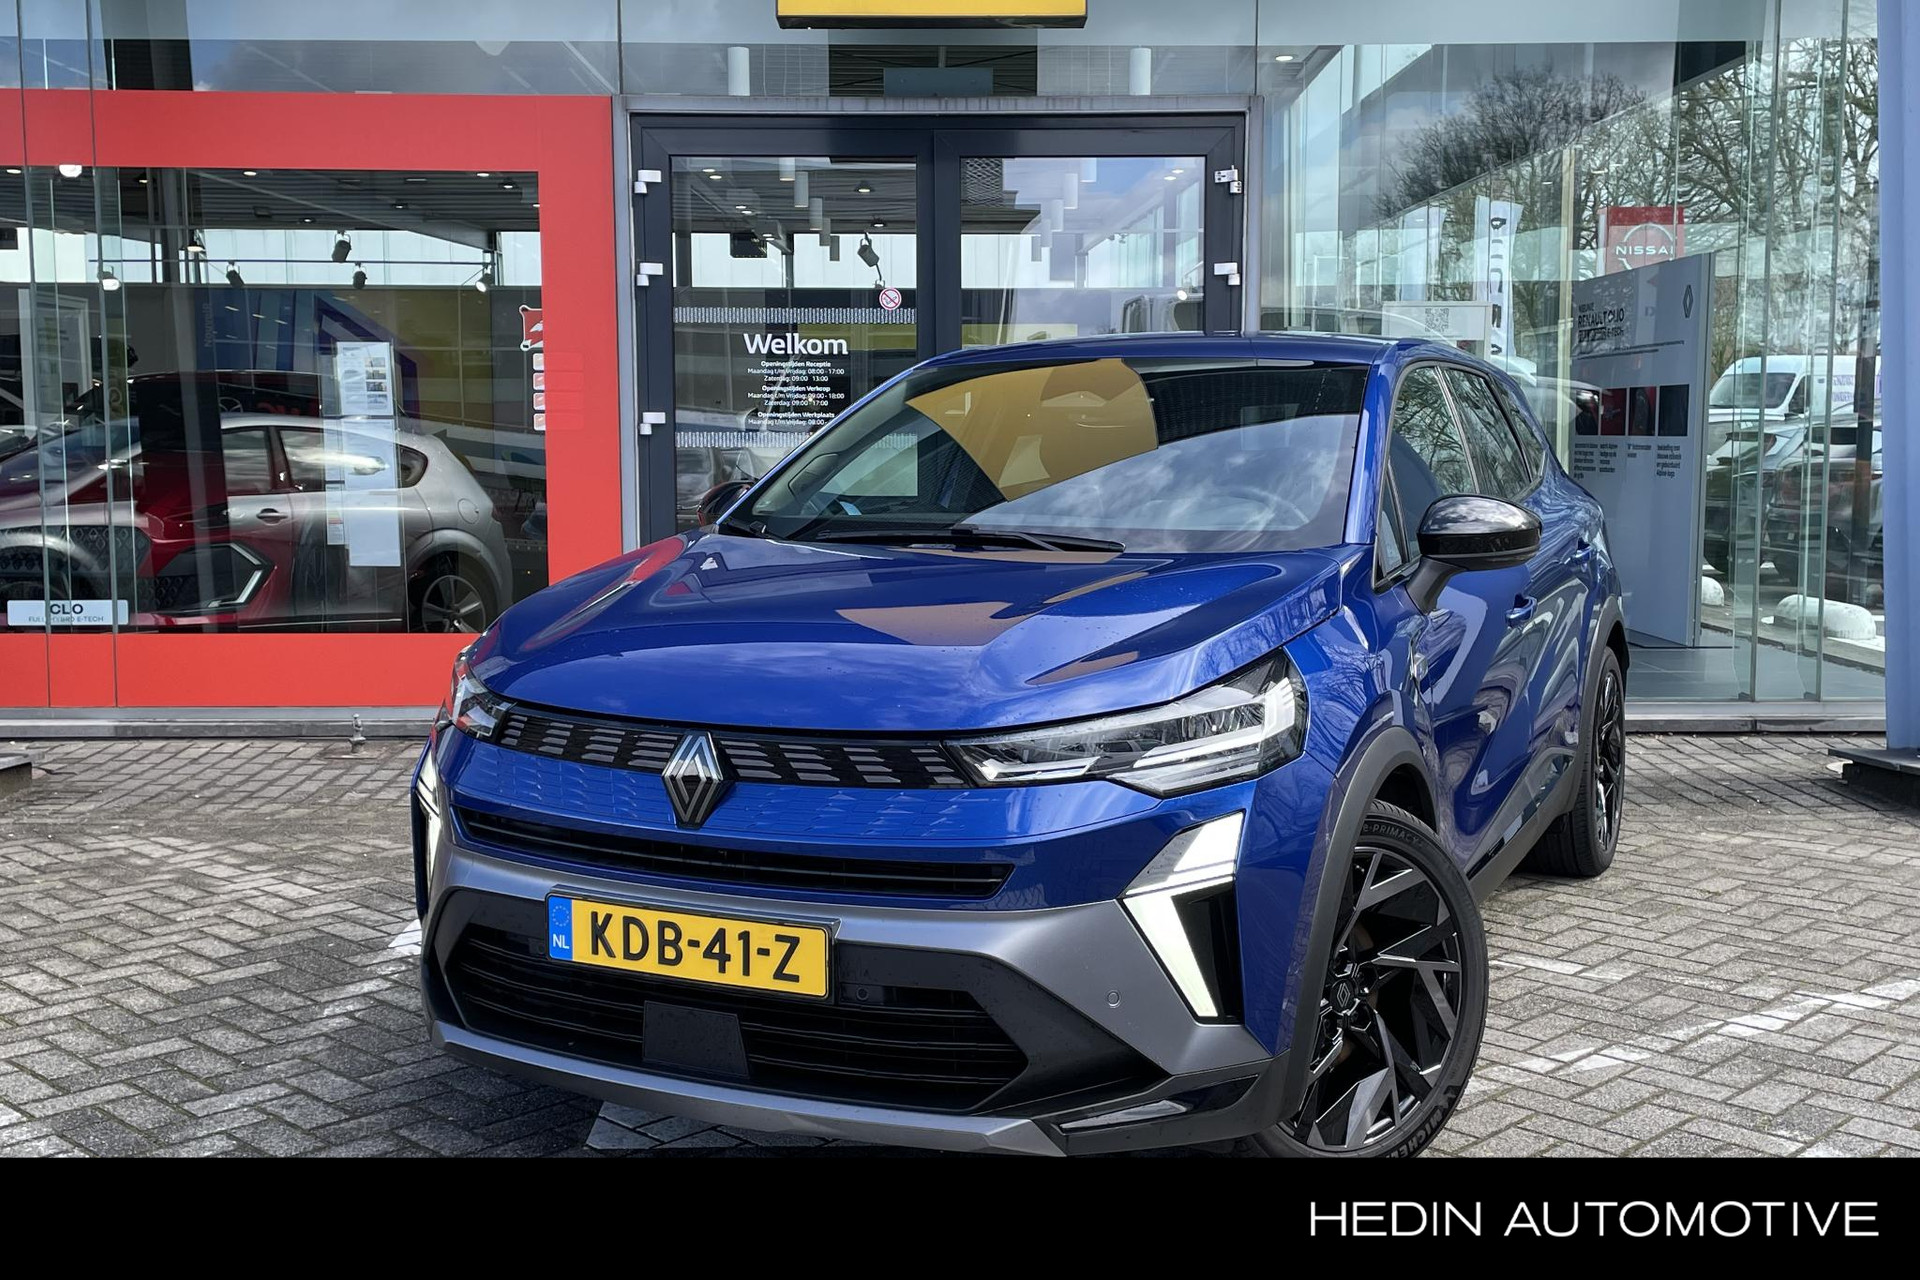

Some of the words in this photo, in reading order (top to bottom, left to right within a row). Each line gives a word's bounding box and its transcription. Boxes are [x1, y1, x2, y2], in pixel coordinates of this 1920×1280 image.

[743, 333, 849, 355] Welkom
[760, 361, 805, 369] Openingstijden
[806, 361, 831, 369] Receptie
[747, 368, 774, 376] Maandag
[761, 385, 806, 393] Openingstijden
[806, 385, 831, 393] Verkoop
[50, 603, 84, 615] CLO
[552, 933, 570, 949] NL
[590, 910, 801, 983] KDB-41-Z
